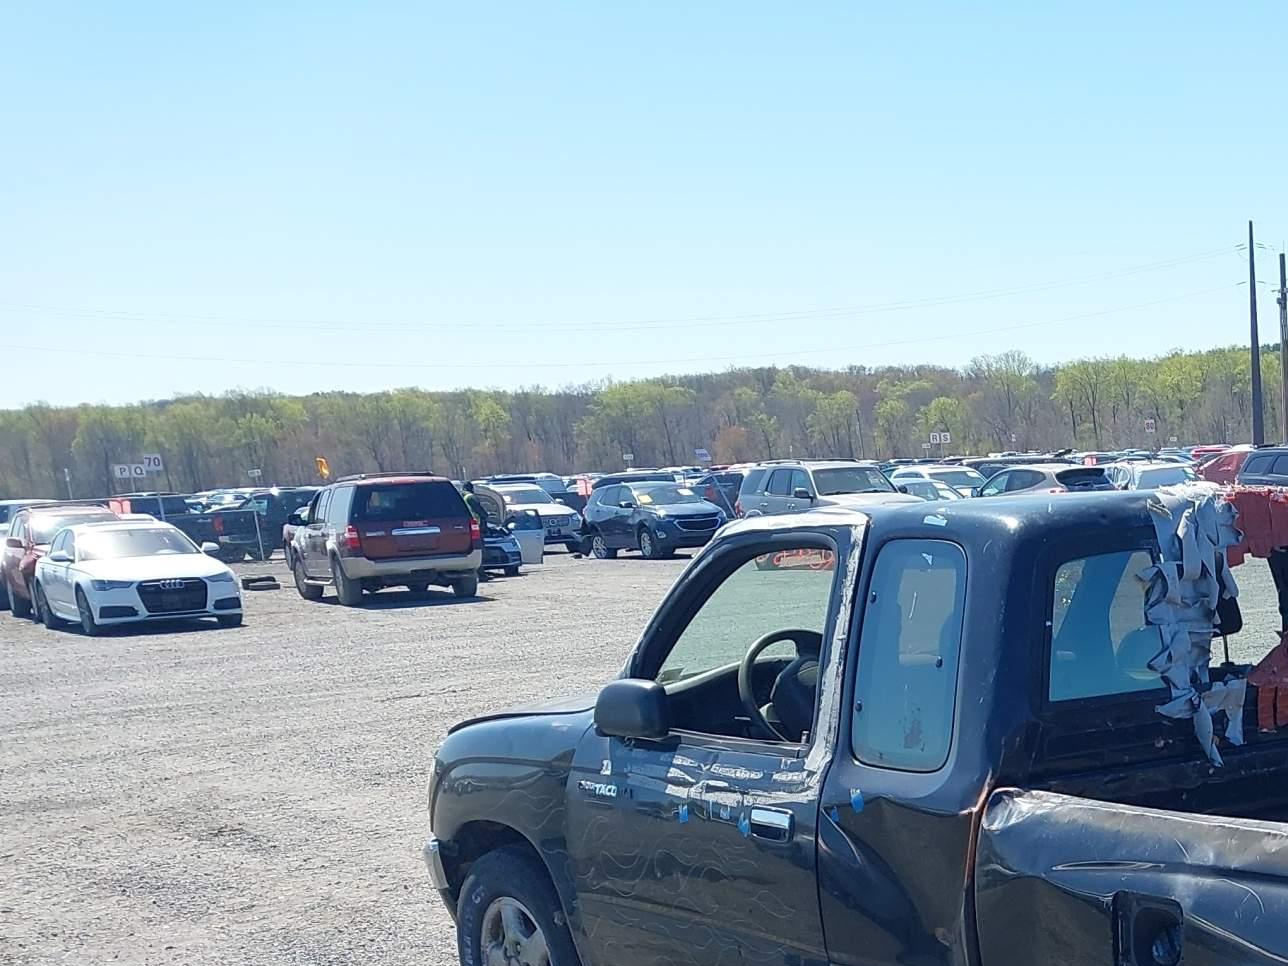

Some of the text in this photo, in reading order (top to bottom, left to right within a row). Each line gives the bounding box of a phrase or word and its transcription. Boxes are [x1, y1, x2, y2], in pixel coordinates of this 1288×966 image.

[144, 456, 161, 468] 70
[119, 466, 145, 476] P Q
